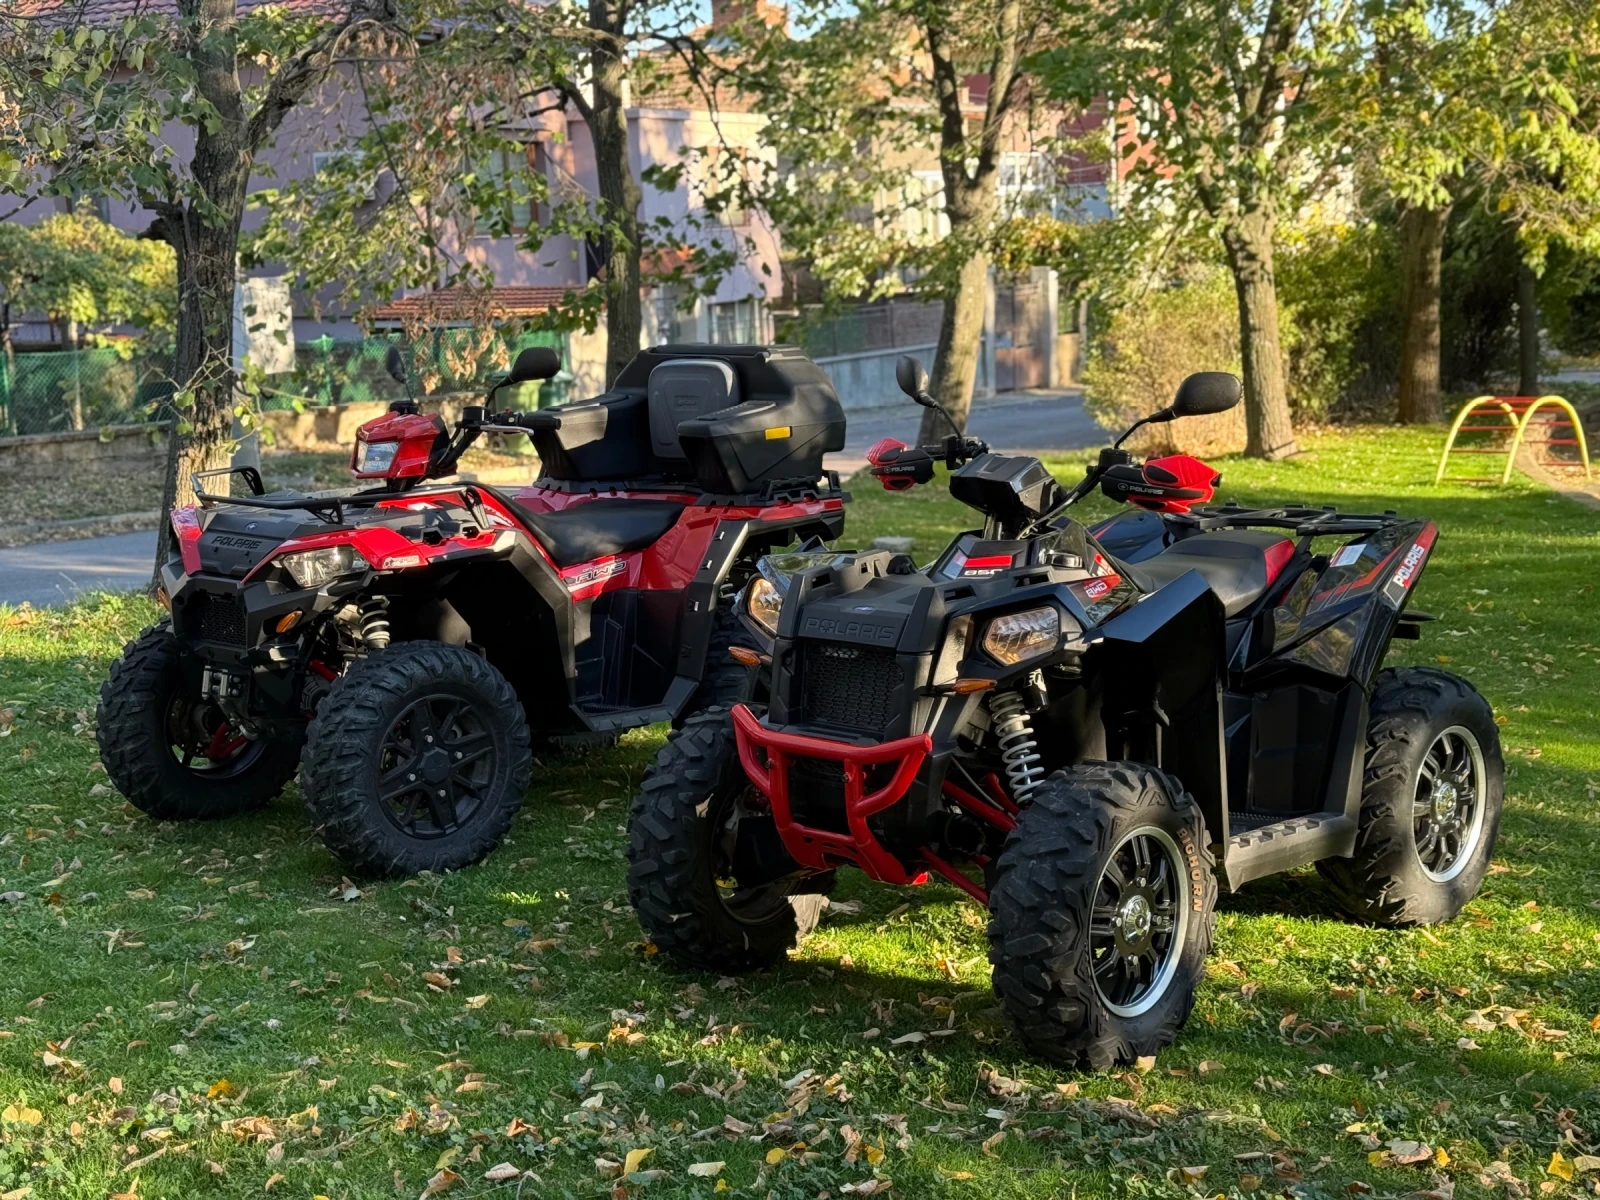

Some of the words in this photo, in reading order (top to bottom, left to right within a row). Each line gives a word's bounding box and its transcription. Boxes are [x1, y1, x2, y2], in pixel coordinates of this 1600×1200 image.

[891, 465, 916, 473] POLARIS
[1129, 485, 1165, 495] POLARIS
[211, 535, 262, 549] POLARIS
[1393, 543, 1424, 588] POLARIS
[804, 617, 896, 640] POLARIS
[1176, 827, 1203, 912] BIGHORN
